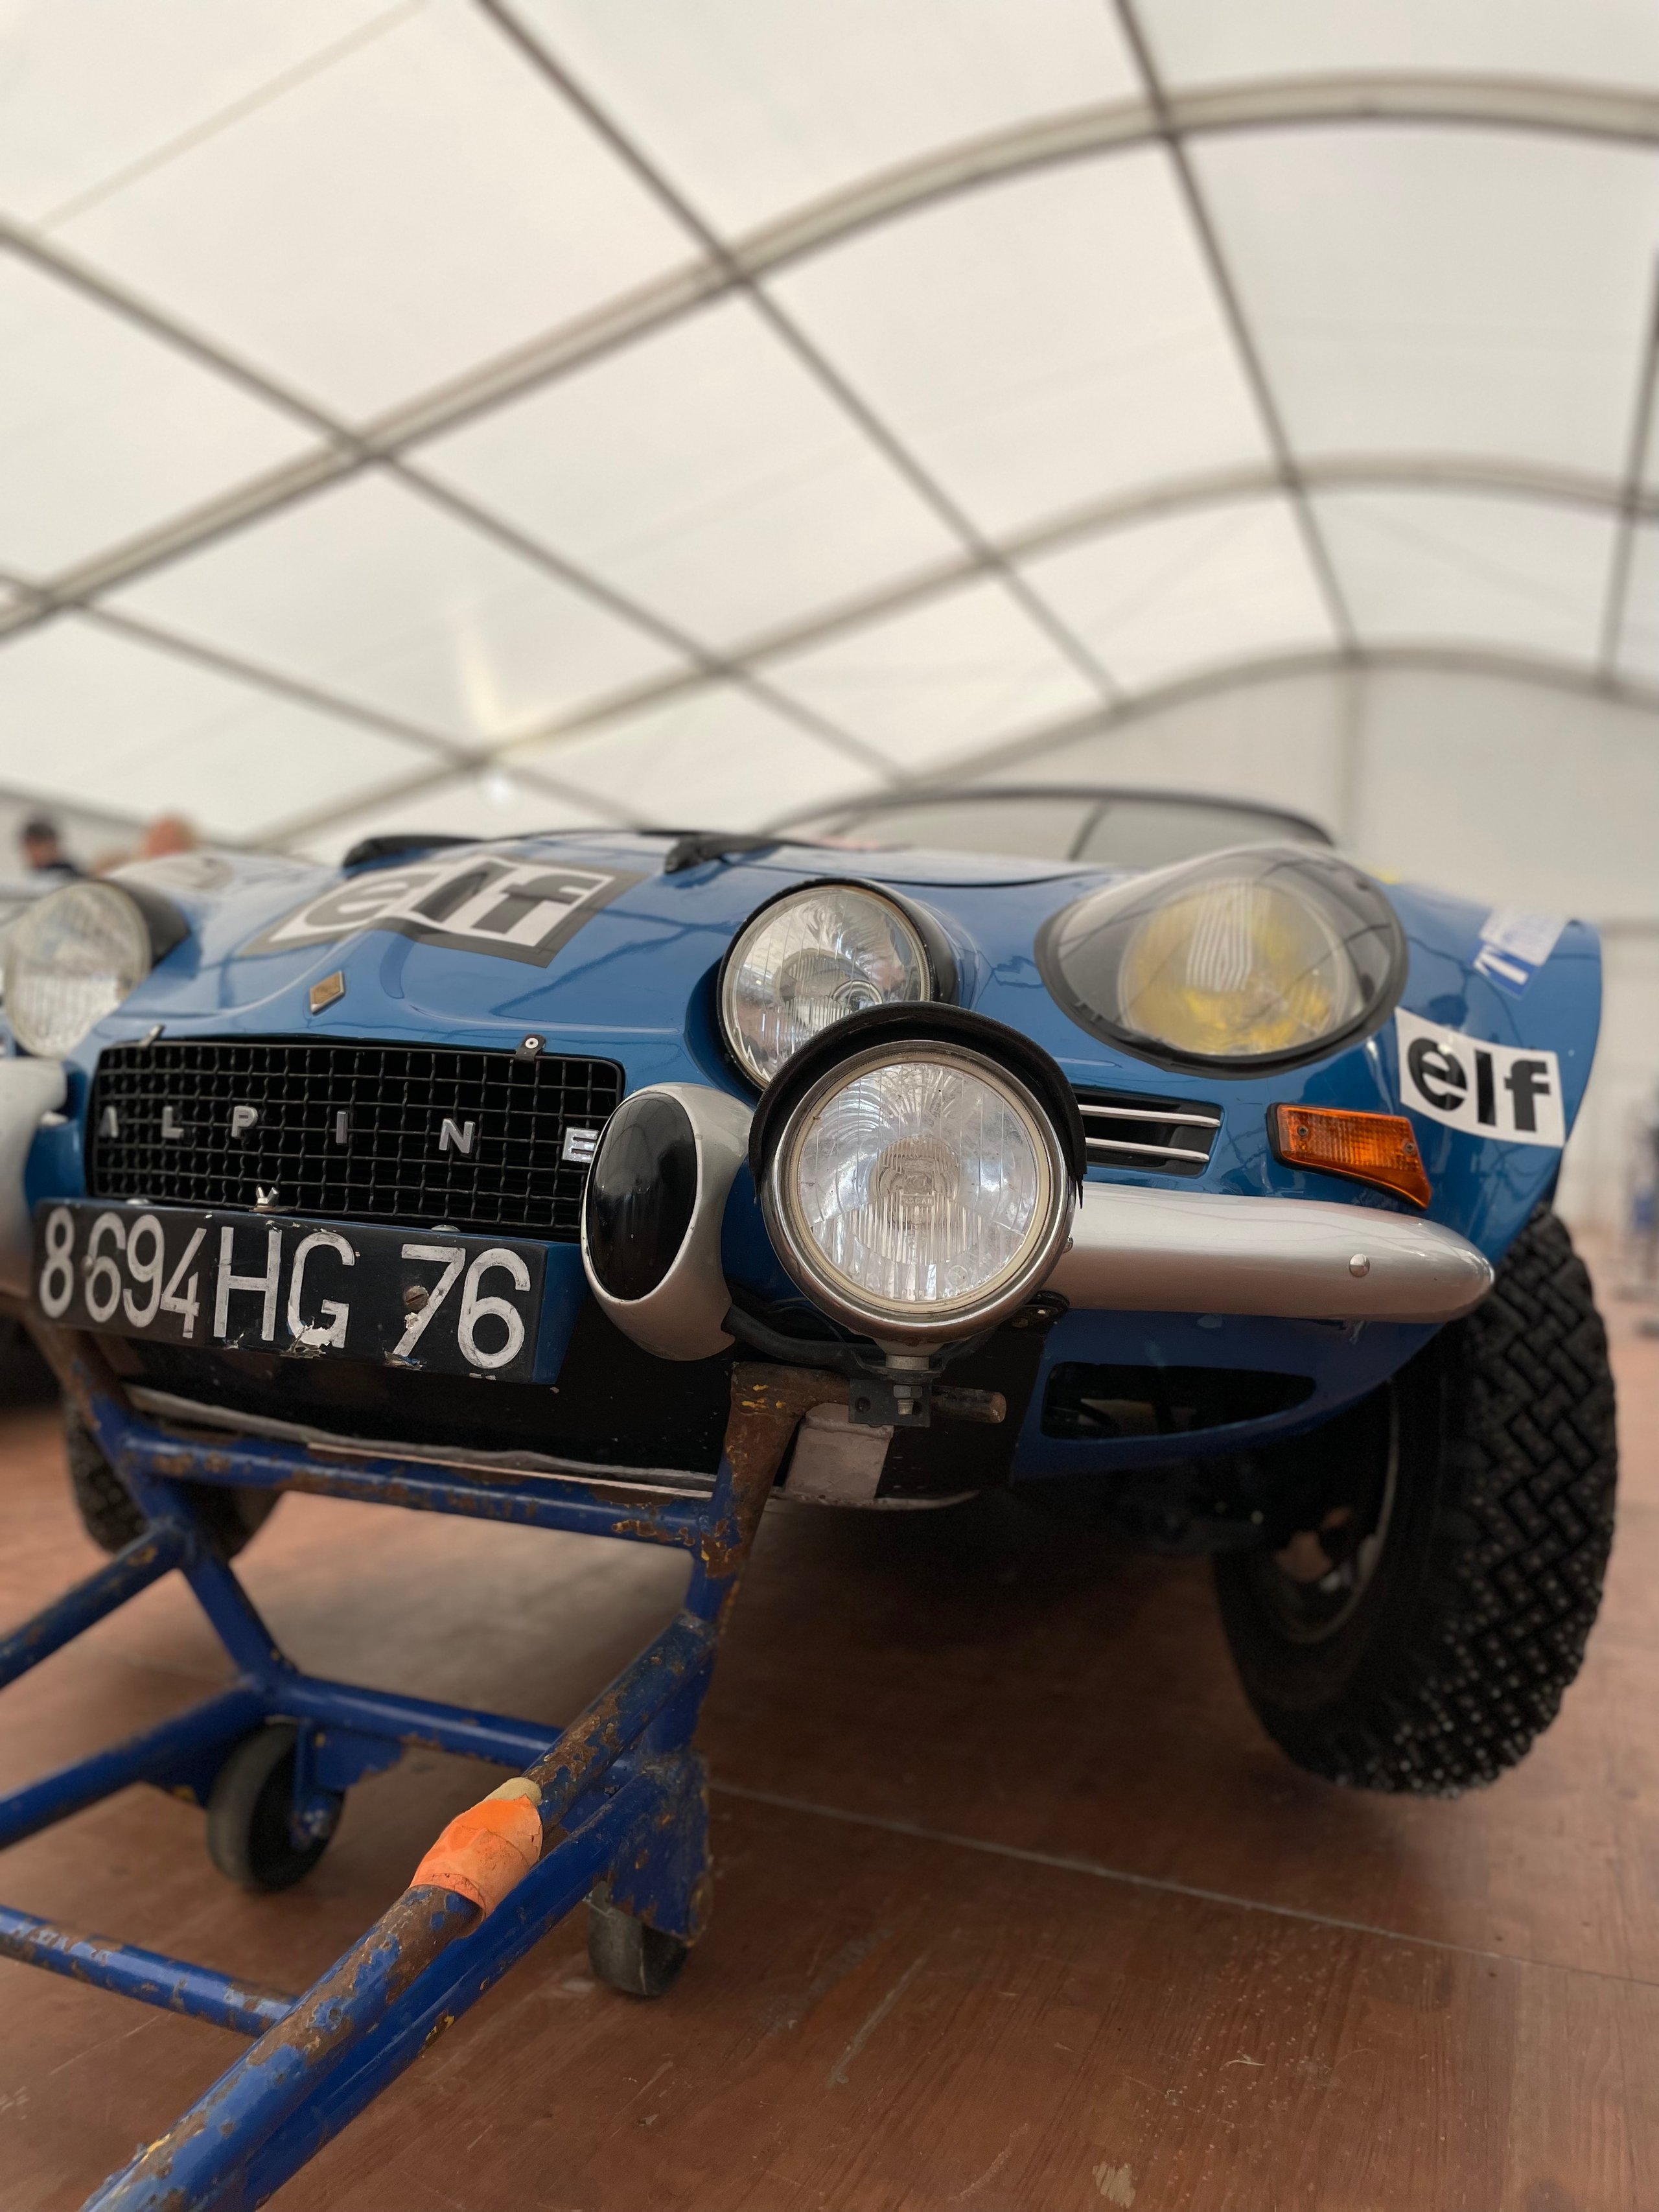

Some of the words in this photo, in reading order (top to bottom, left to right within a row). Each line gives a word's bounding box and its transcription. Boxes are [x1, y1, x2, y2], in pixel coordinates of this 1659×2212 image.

[304, 861, 604, 935] elf
[1408, 1038, 1551, 1133] elf
[98, 1105, 599, 1163] ALPINE
[393, 1244, 531, 1370] 76
